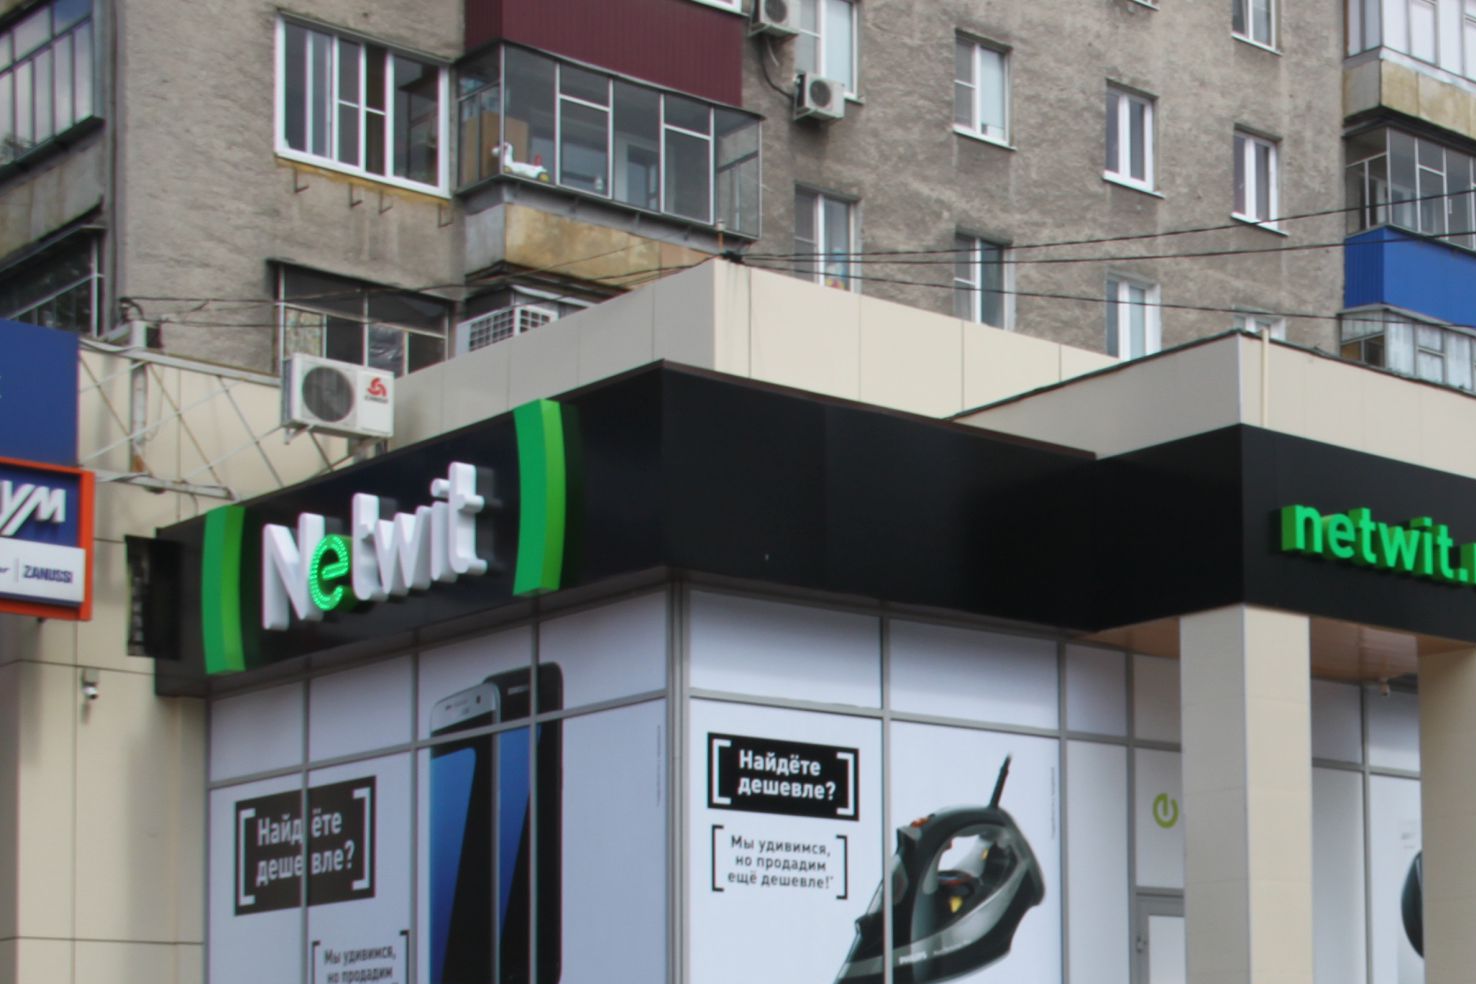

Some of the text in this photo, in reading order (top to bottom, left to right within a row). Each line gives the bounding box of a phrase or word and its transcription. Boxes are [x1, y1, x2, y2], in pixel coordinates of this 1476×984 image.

[263, 461, 488, 631] Netwit
[23, 564, 73, 583] ZANUSSI
[739, 750, 821, 776] Найдёте
[737, 777, 836, 800] дешевле?
[257, 808, 342, 847] Найдёте
[731, 835, 831, 857] Мы удивимся,
[256, 839, 355, 888] дешевле?
[735, 856, 826, 871] но продадим
[728, 871, 757, 885] ещё
[324, 945, 396, 966] Мы удивимся,
[327, 966, 393, 984] но продадим
